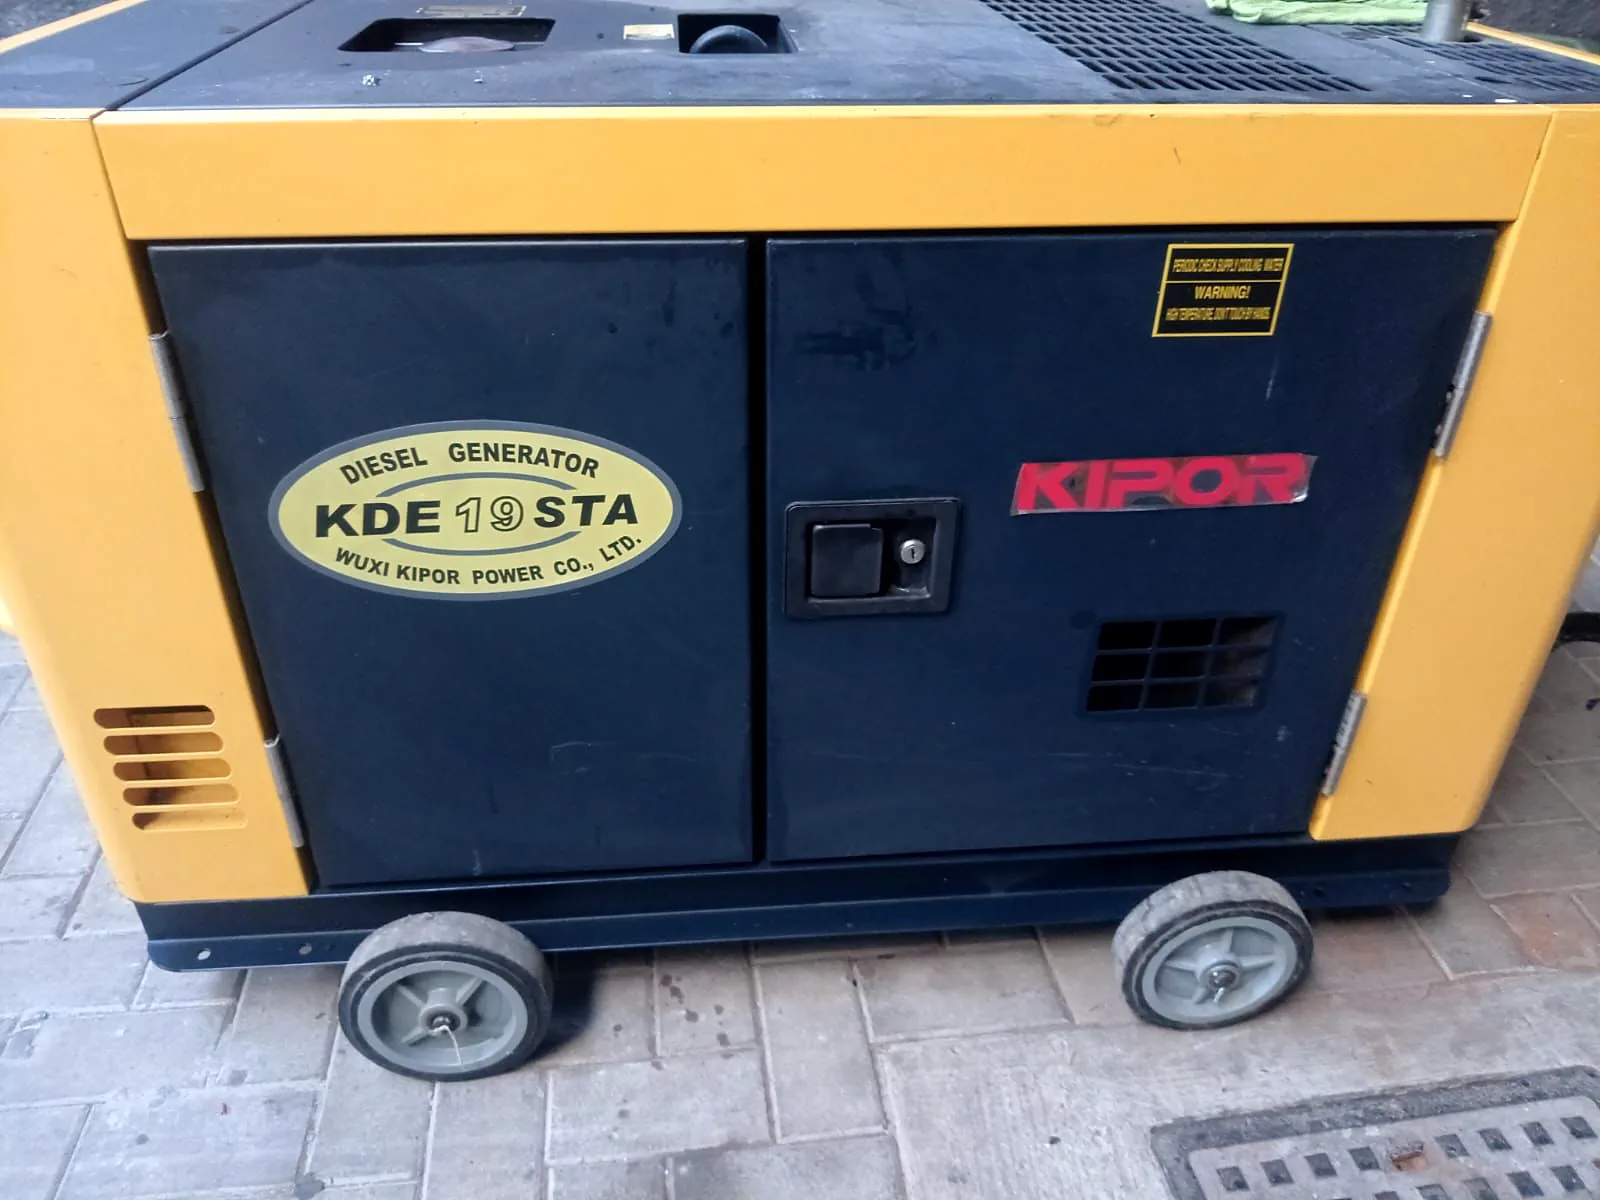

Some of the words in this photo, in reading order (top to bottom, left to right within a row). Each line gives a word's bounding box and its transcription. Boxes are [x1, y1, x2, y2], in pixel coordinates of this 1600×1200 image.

[1198, 258, 1218, 272] CHECK
[1216, 258, 1239, 272] SUPPLY
[1237, 258, 1263, 271] COOLING
[1263, 258, 1284, 271] WATER
[1195, 286, 1251, 299] WARNING!
[340, 447, 427, 485] DIESEL
[448, 442, 599, 479] GENERATOR
[1016, 453, 1307, 511] KIPOR
[315, 500, 441, 538] KDE
[454, 495, 524, 533] 19
[534, 494, 638, 528] STA
[335, 547, 391, 578] WUXI
[396, 563, 461, 585] KIPOR
[473, 566, 544, 585] POWER
[554, 557, 595, 577] CO.,
[600, 535, 642, 563] LTD.
